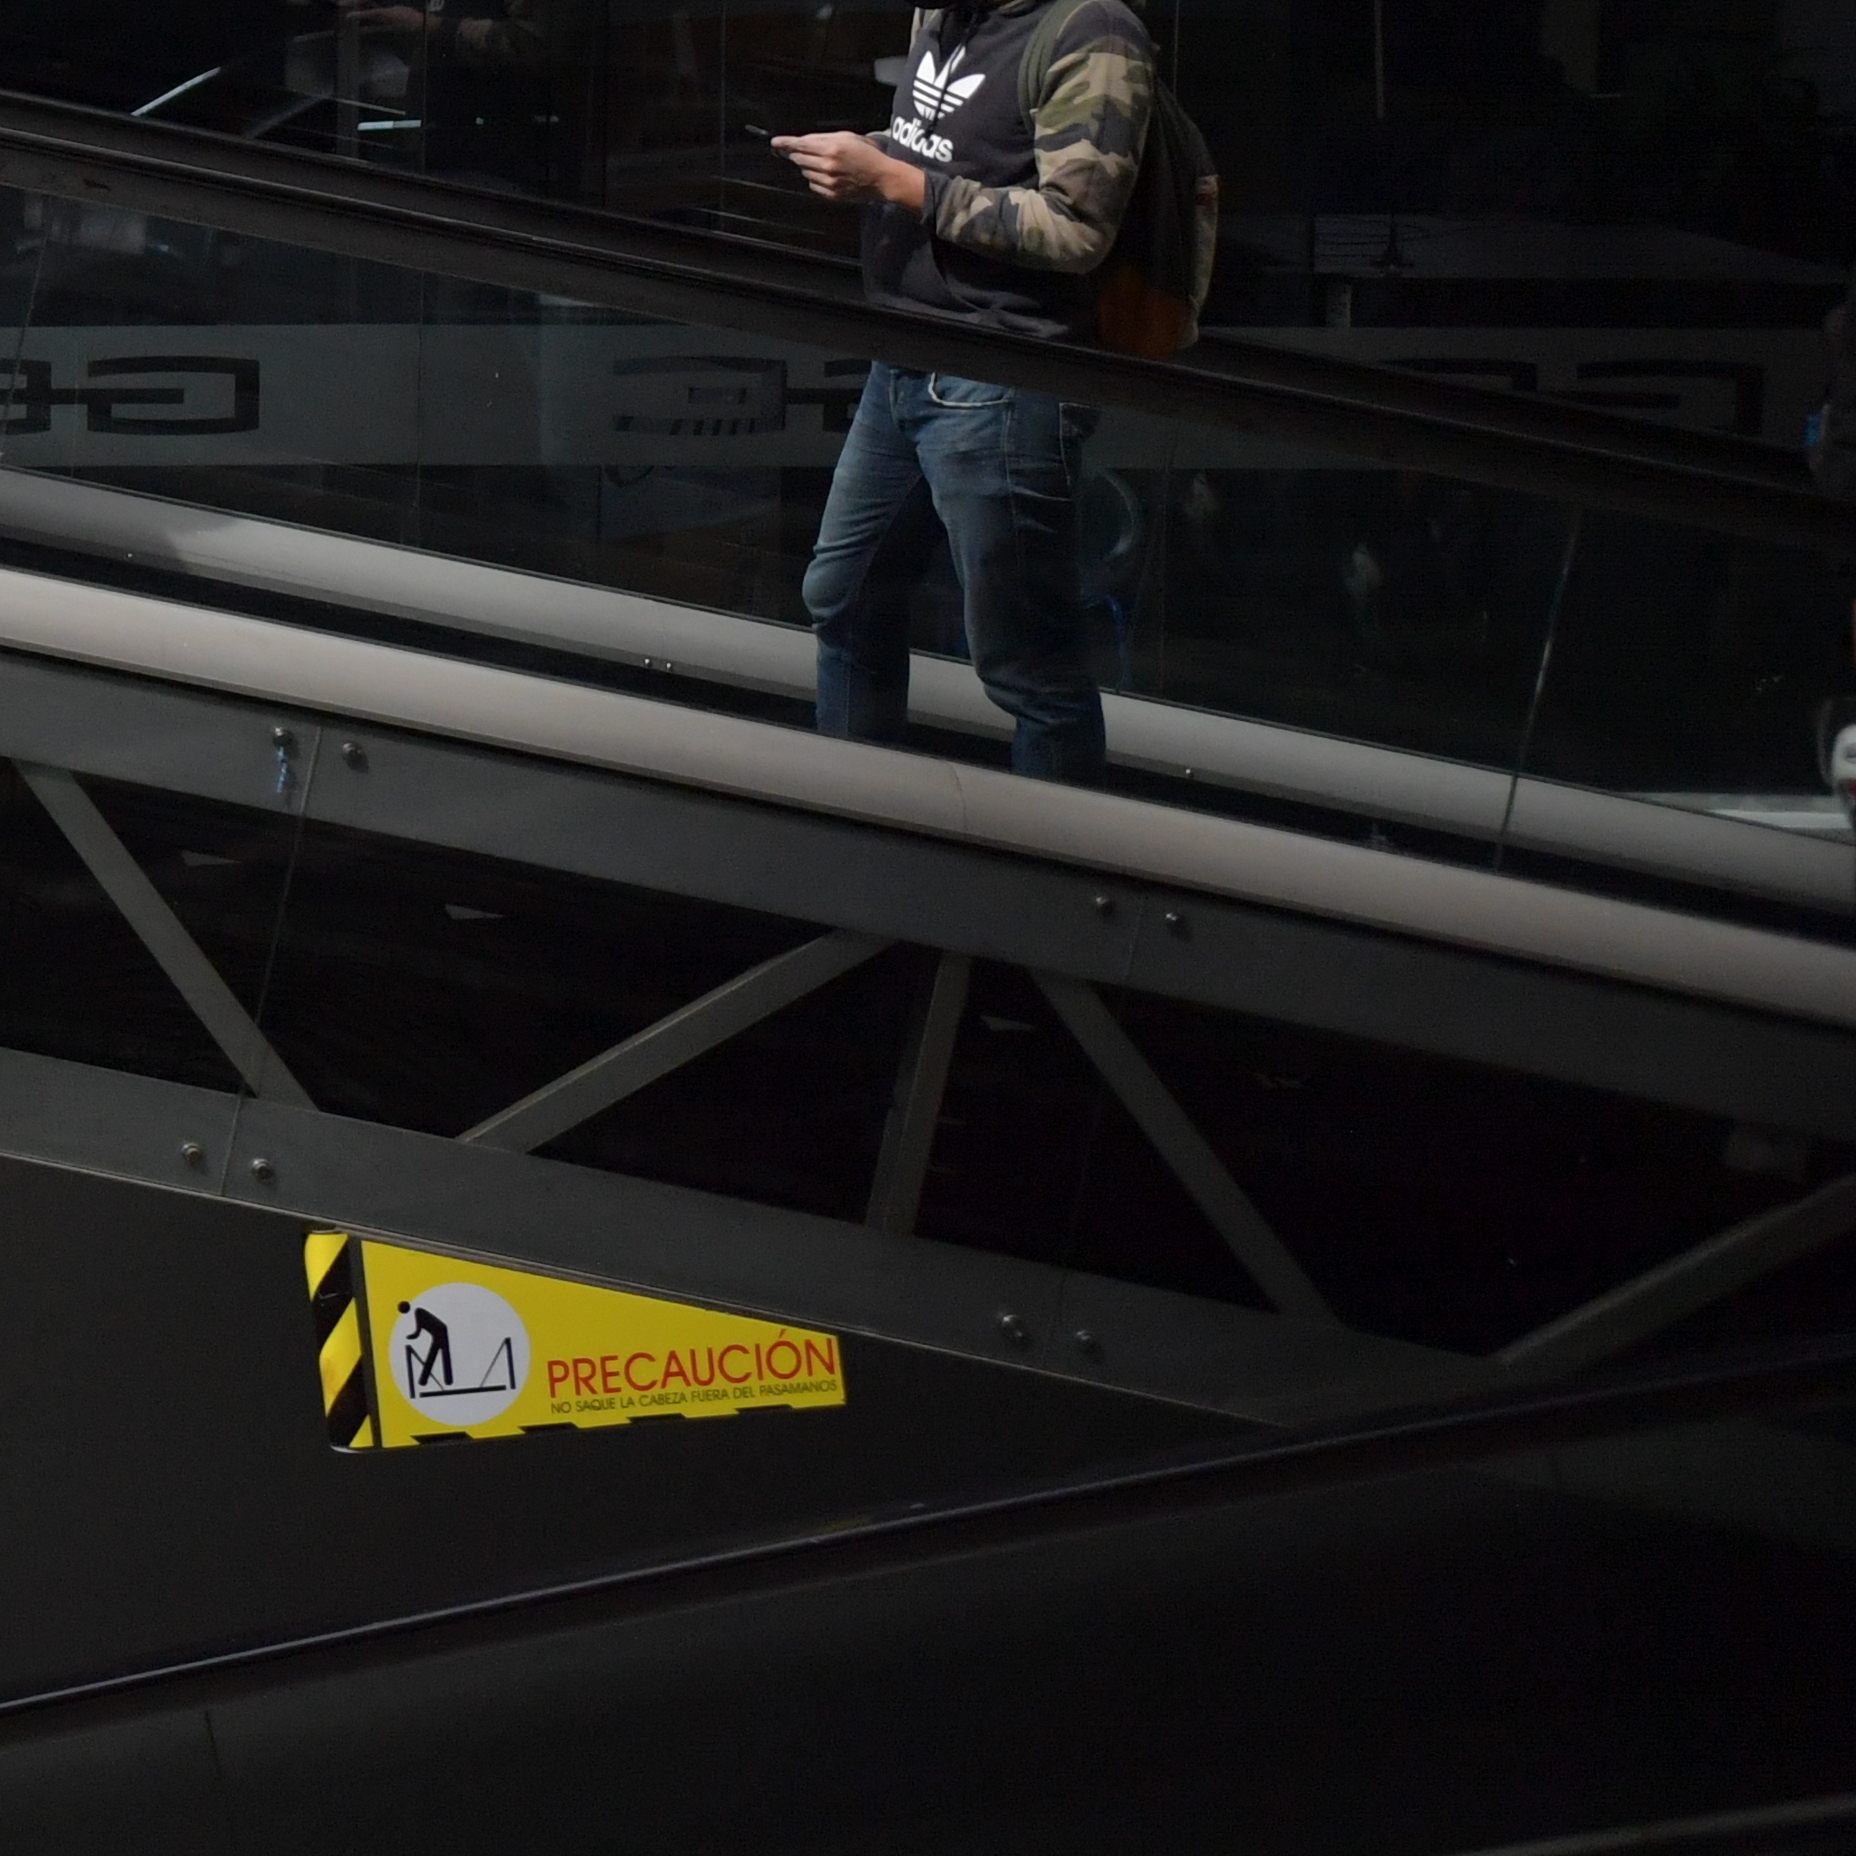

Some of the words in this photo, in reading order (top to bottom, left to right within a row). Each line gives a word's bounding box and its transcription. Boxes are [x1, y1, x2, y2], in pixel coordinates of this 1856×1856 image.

[892, 115, 954, 163] adidas
[547, 1328, 836, 1399] PRECAUCIÓN
[550, 1401, 572, 1414] NO
[575, 1398, 617, 1413] SAQUE
[620, 1396, 636, 1409] LA
[638, 1391, 688, 1407] CABEZA
[690, 1388, 729, 1403] FUERA
[732, 1386, 755, 1400] DEL
[759, 1379, 838, 1397] PASAMANOS
